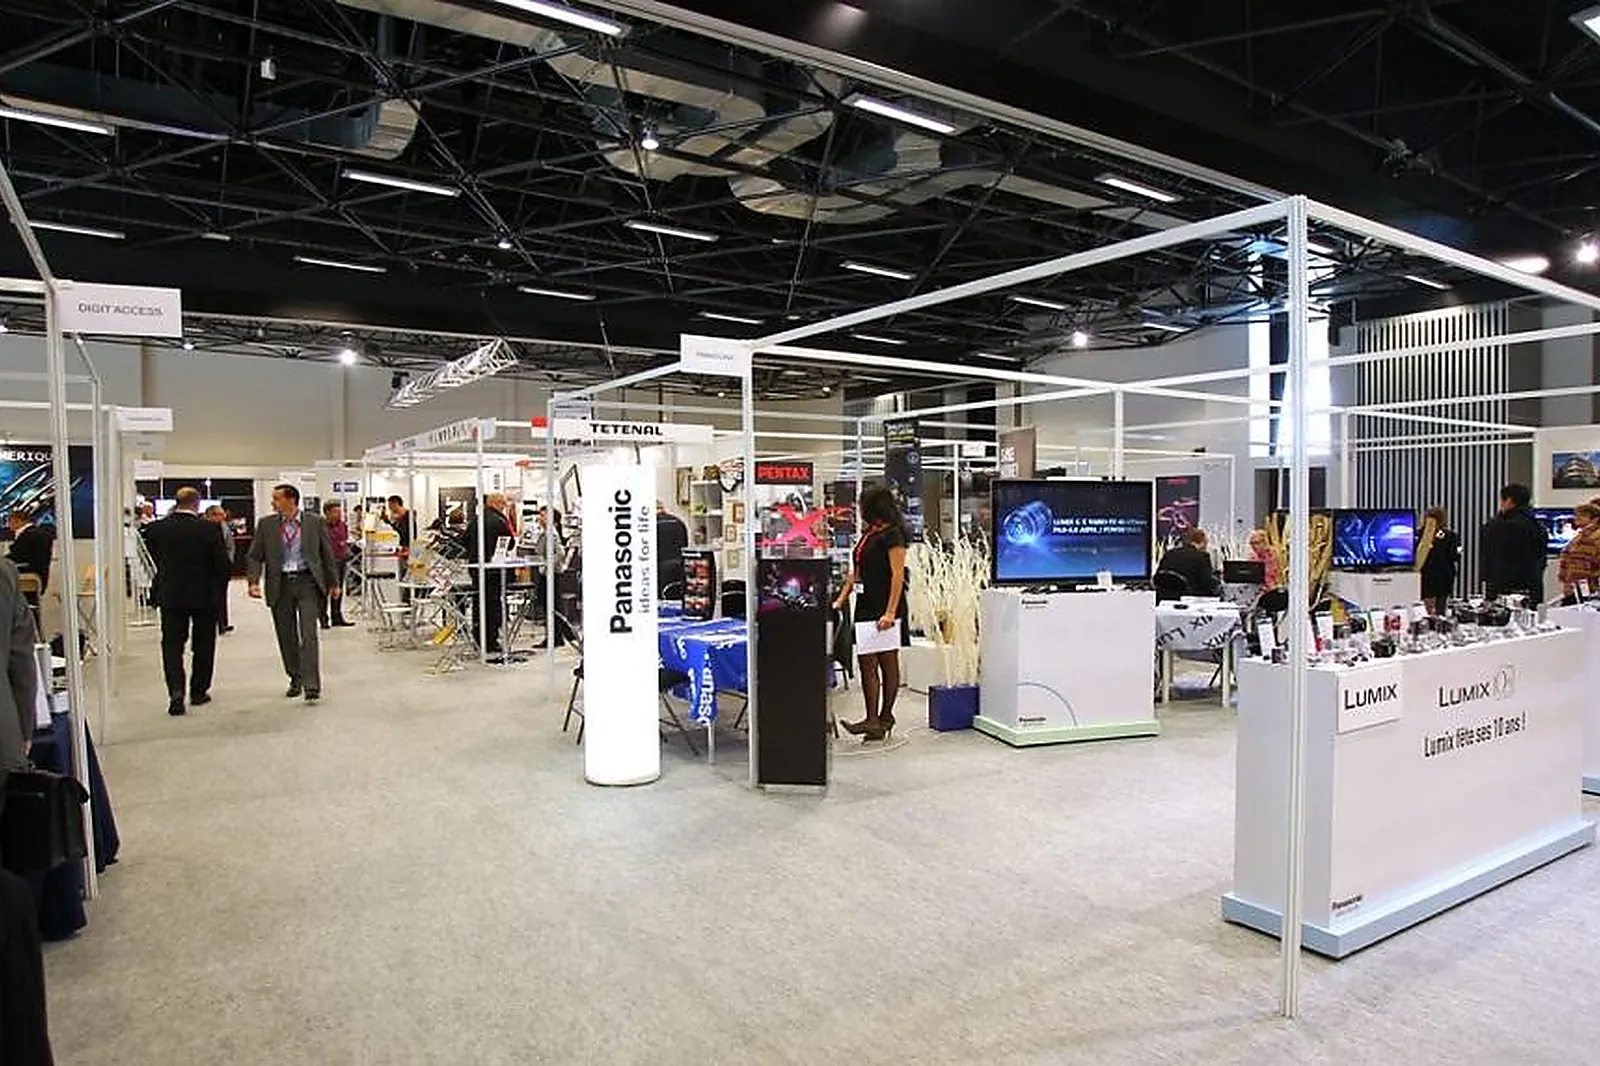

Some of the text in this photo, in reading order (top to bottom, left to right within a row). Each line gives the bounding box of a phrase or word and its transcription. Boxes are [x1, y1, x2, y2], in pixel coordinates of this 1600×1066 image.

[589, 423, 664, 436] TETENAL
[757, 466, 810, 479] PENTAX
[608, 489, 633, 634] Panasonic
[638, 505, 650, 614] ideas for life
[1343, 683, 1399, 710] LUMIX
[1438, 681, 1490, 708] LUMIX
[1424, 731, 1454, 758] Lumix
[1475, 724, 1492, 743] ses
[1493, 717, 1504, 739] 10
[1504, 717, 1521, 735] ans
